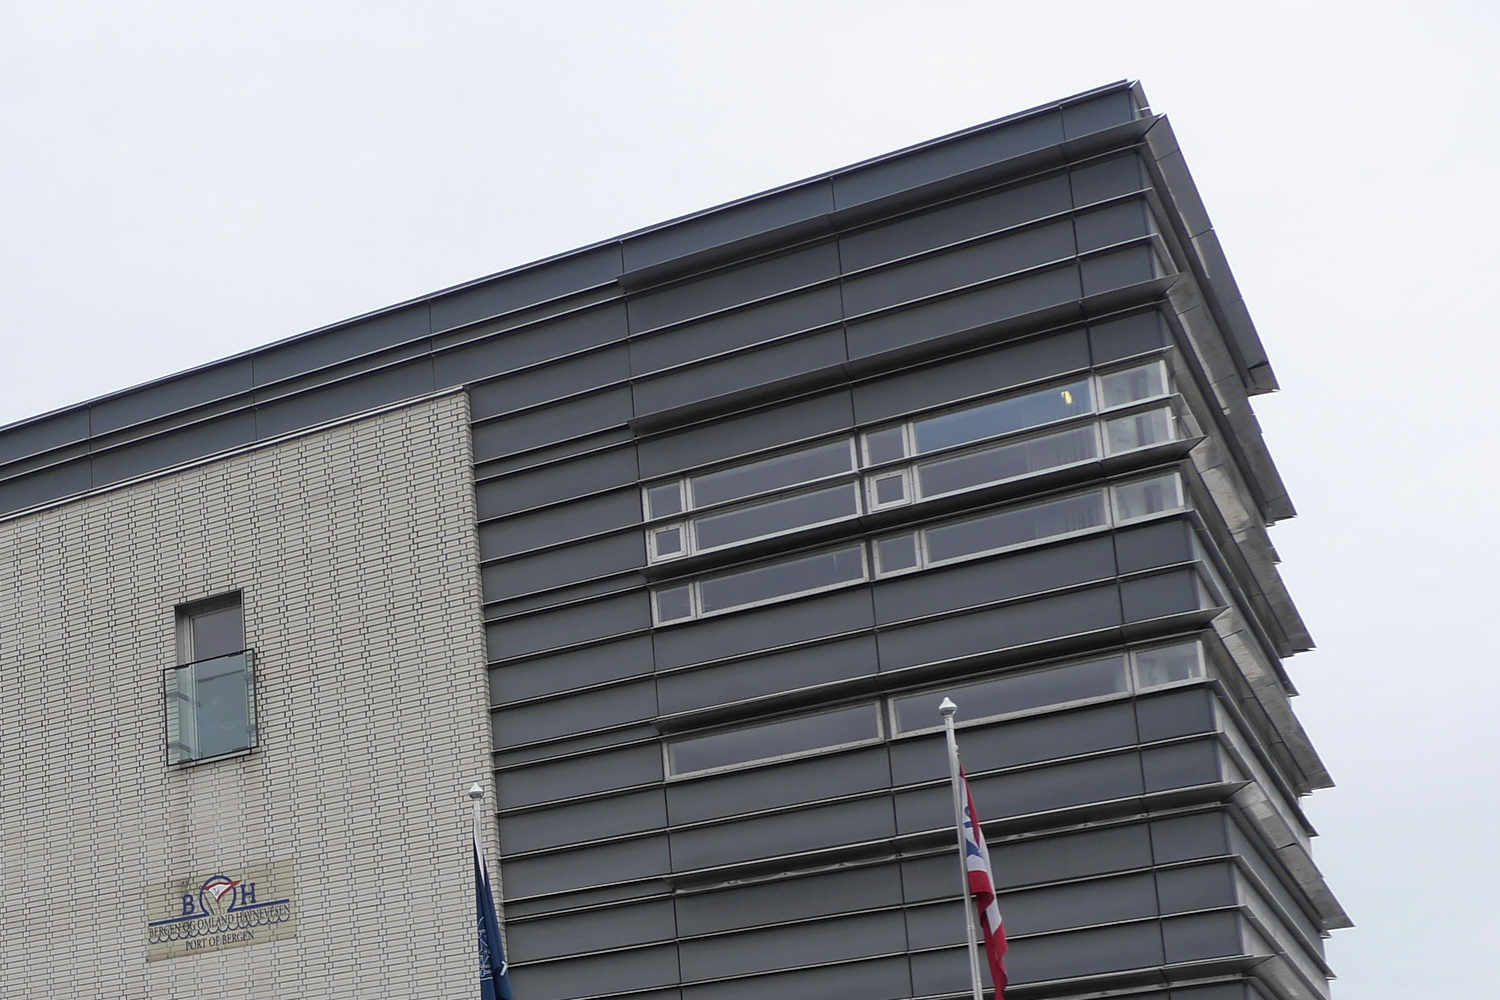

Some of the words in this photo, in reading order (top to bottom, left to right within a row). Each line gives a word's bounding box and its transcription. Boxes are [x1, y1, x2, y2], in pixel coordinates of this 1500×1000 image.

[149, 923, 181, 938] BERGEN
[198, 913, 234, 928] OMLAND
[185, 937, 208, 951] PORT
[208, 935, 220, 947] OF
[222, 930, 255, 945] BERGEN
